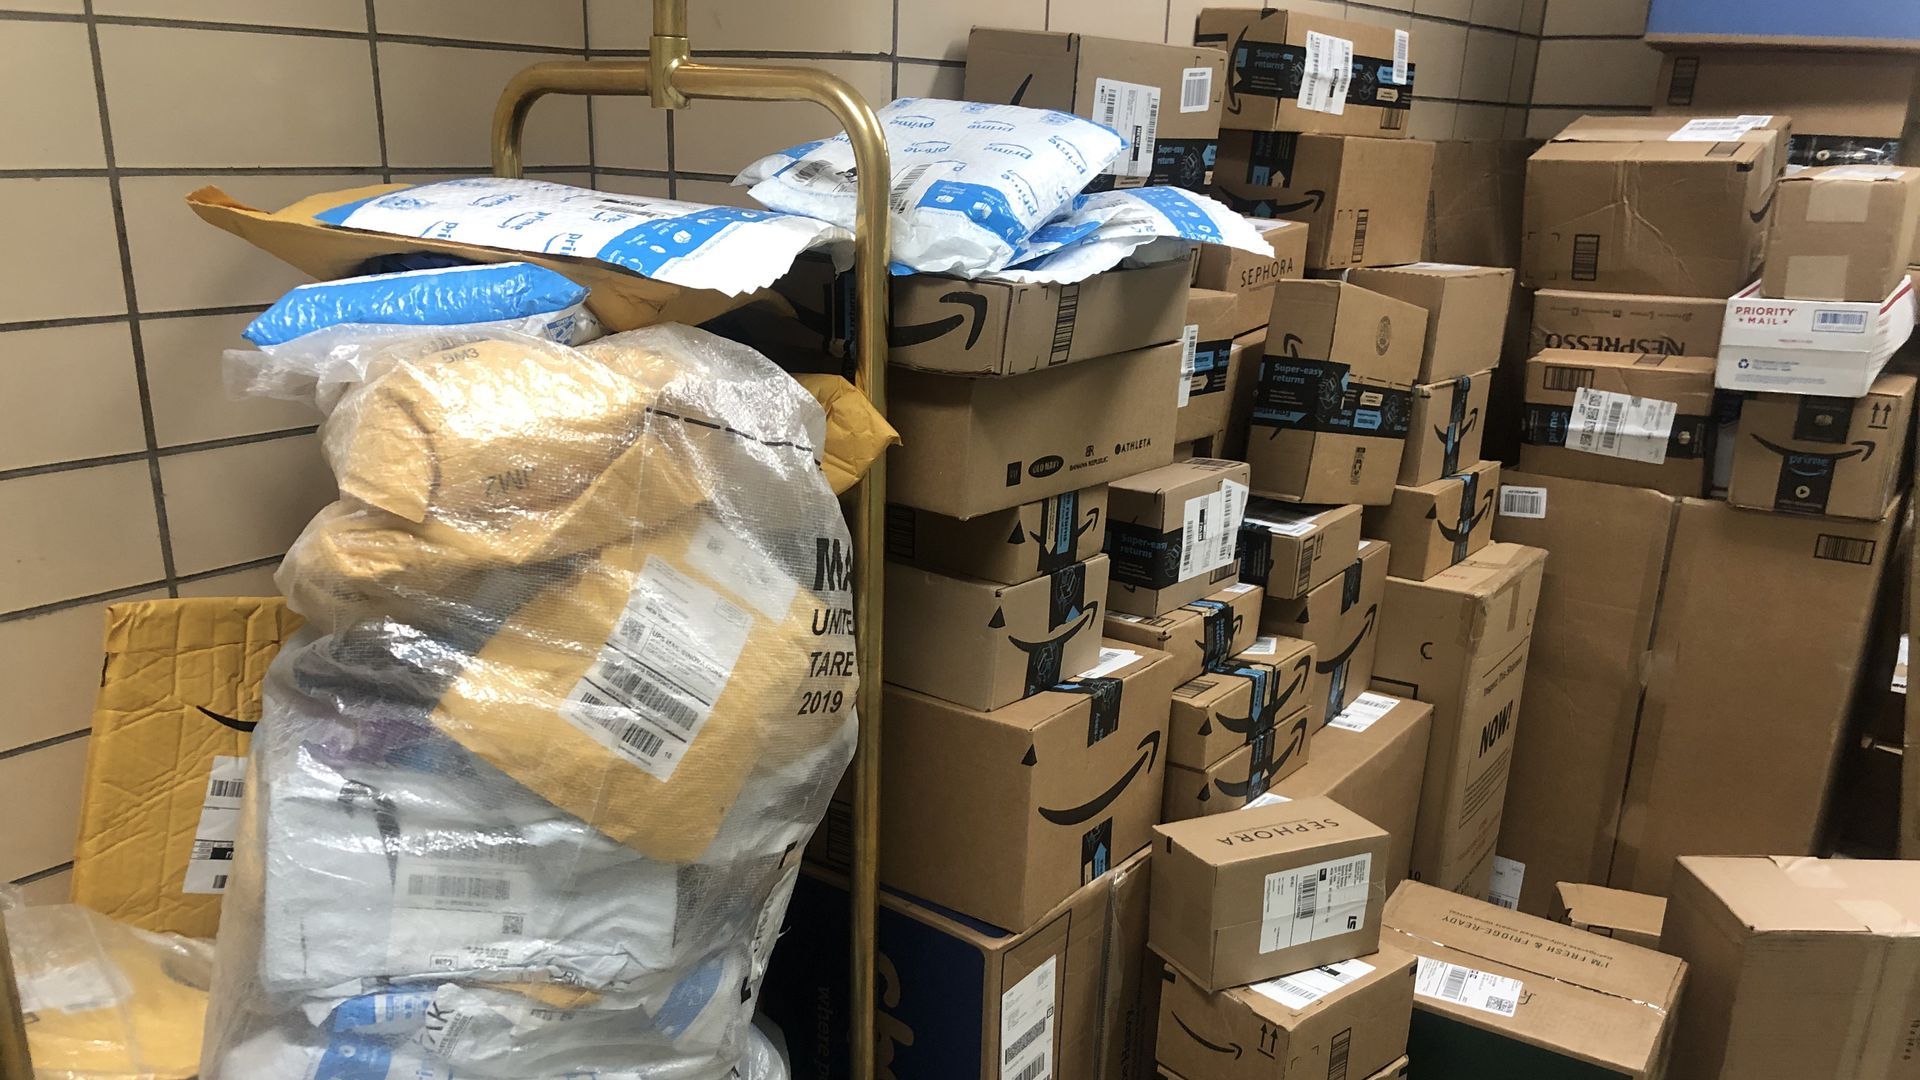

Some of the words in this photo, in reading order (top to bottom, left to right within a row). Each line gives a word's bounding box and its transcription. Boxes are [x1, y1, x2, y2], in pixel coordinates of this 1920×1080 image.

[1254, 60, 1284, 71] returns
[889, 119, 935, 130] prime
[967, 123, 1014, 133] prime
[984, 146, 1032, 160] prime
[1240, 257, 1294, 288] SEPHORA
[1736, 306, 1795, 318] PRIORITY
[1748, 316, 1779, 326] MAIL
[1545, 332, 1685, 356] NESPRESSO
[1274, 362, 1324, 378] Super-easy
[1273, 373, 1305, 385] returns
[1548, 411, 1560, 444] prime
[1121, 438, 1151, 454] ATHLETA
[1789, 455, 1830, 466] prime
[810, 651, 853, 678] TARE
[798, 690, 843, 715] 2019
[1479, 700, 1514, 759] NOW!
[1217, 818, 1340, 846] SEPHORA
[1441, 911, 1529, 947] FRIDGE-READY
[1545, 943, 1586, 963] FRESH
[1590, 957, 1609, 969] I'M
